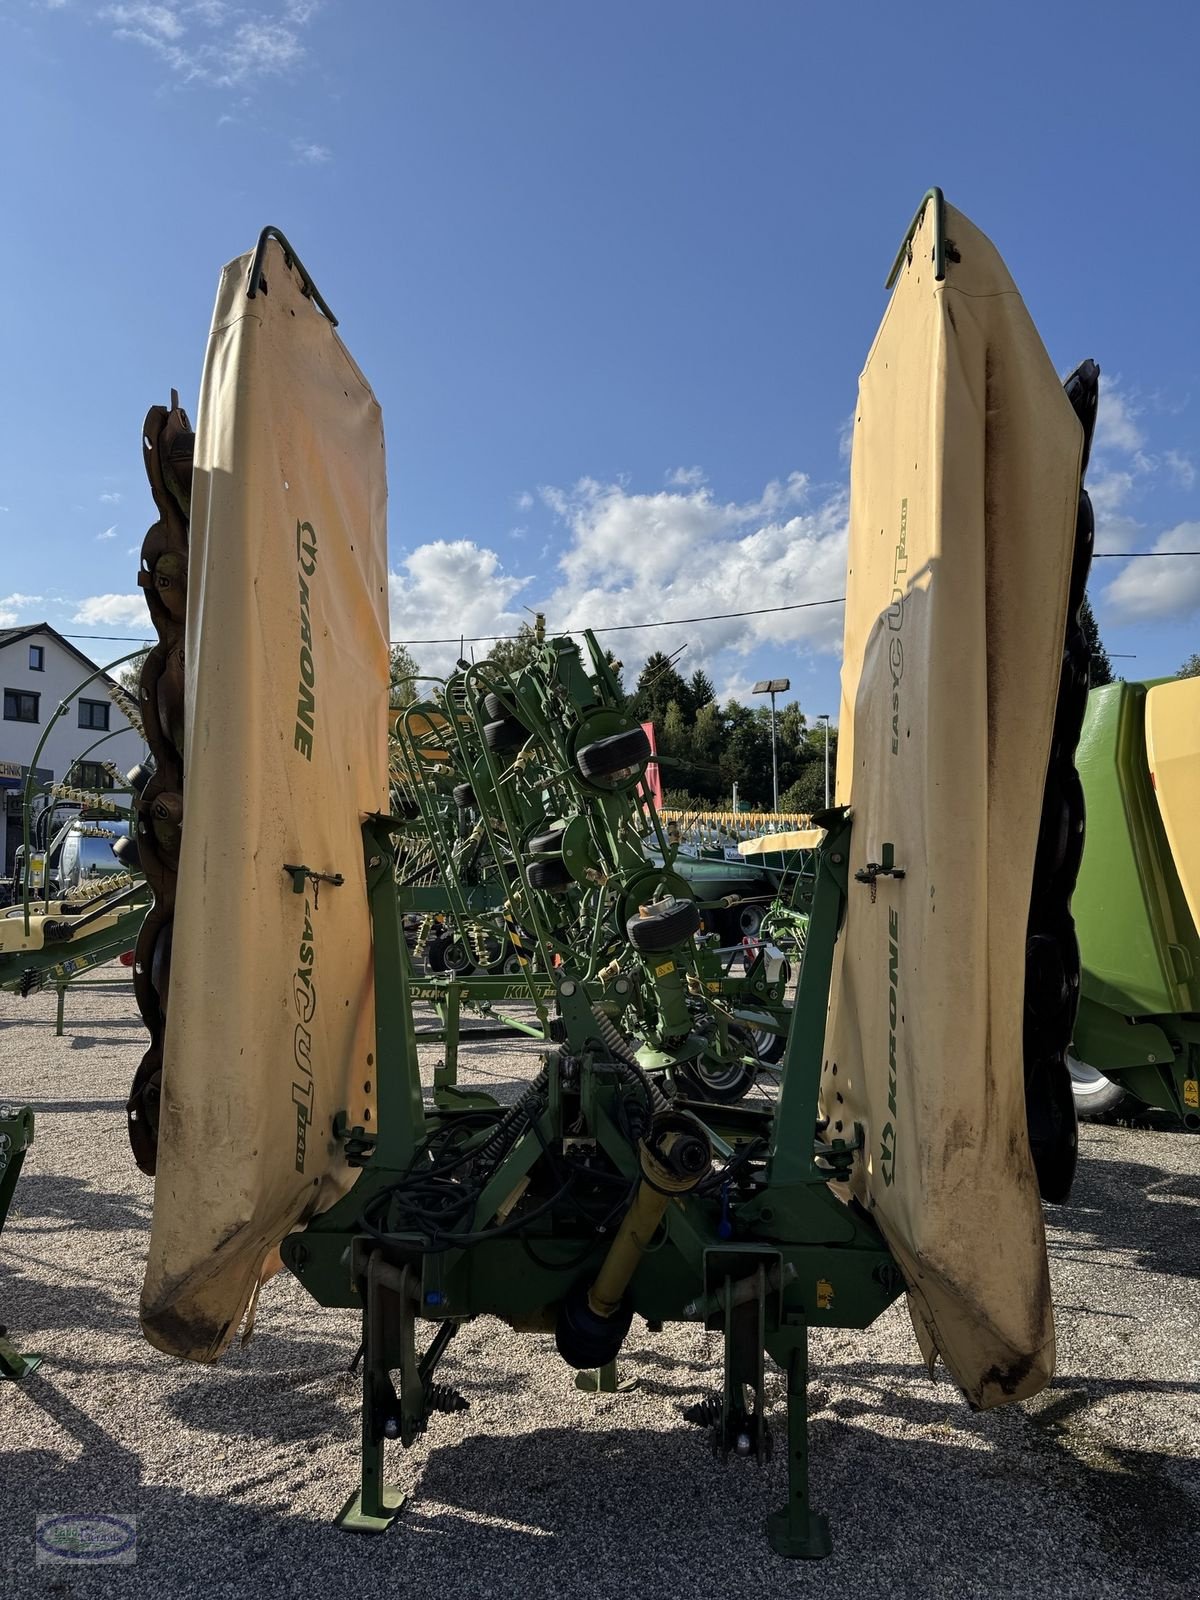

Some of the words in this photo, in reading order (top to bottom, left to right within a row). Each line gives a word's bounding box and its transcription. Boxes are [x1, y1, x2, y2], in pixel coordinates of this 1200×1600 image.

[294, 571, 315, 763] KRONE
[888, 905, 898, 1119] KRONE
[296, 1113, 306, 1163] 7540
